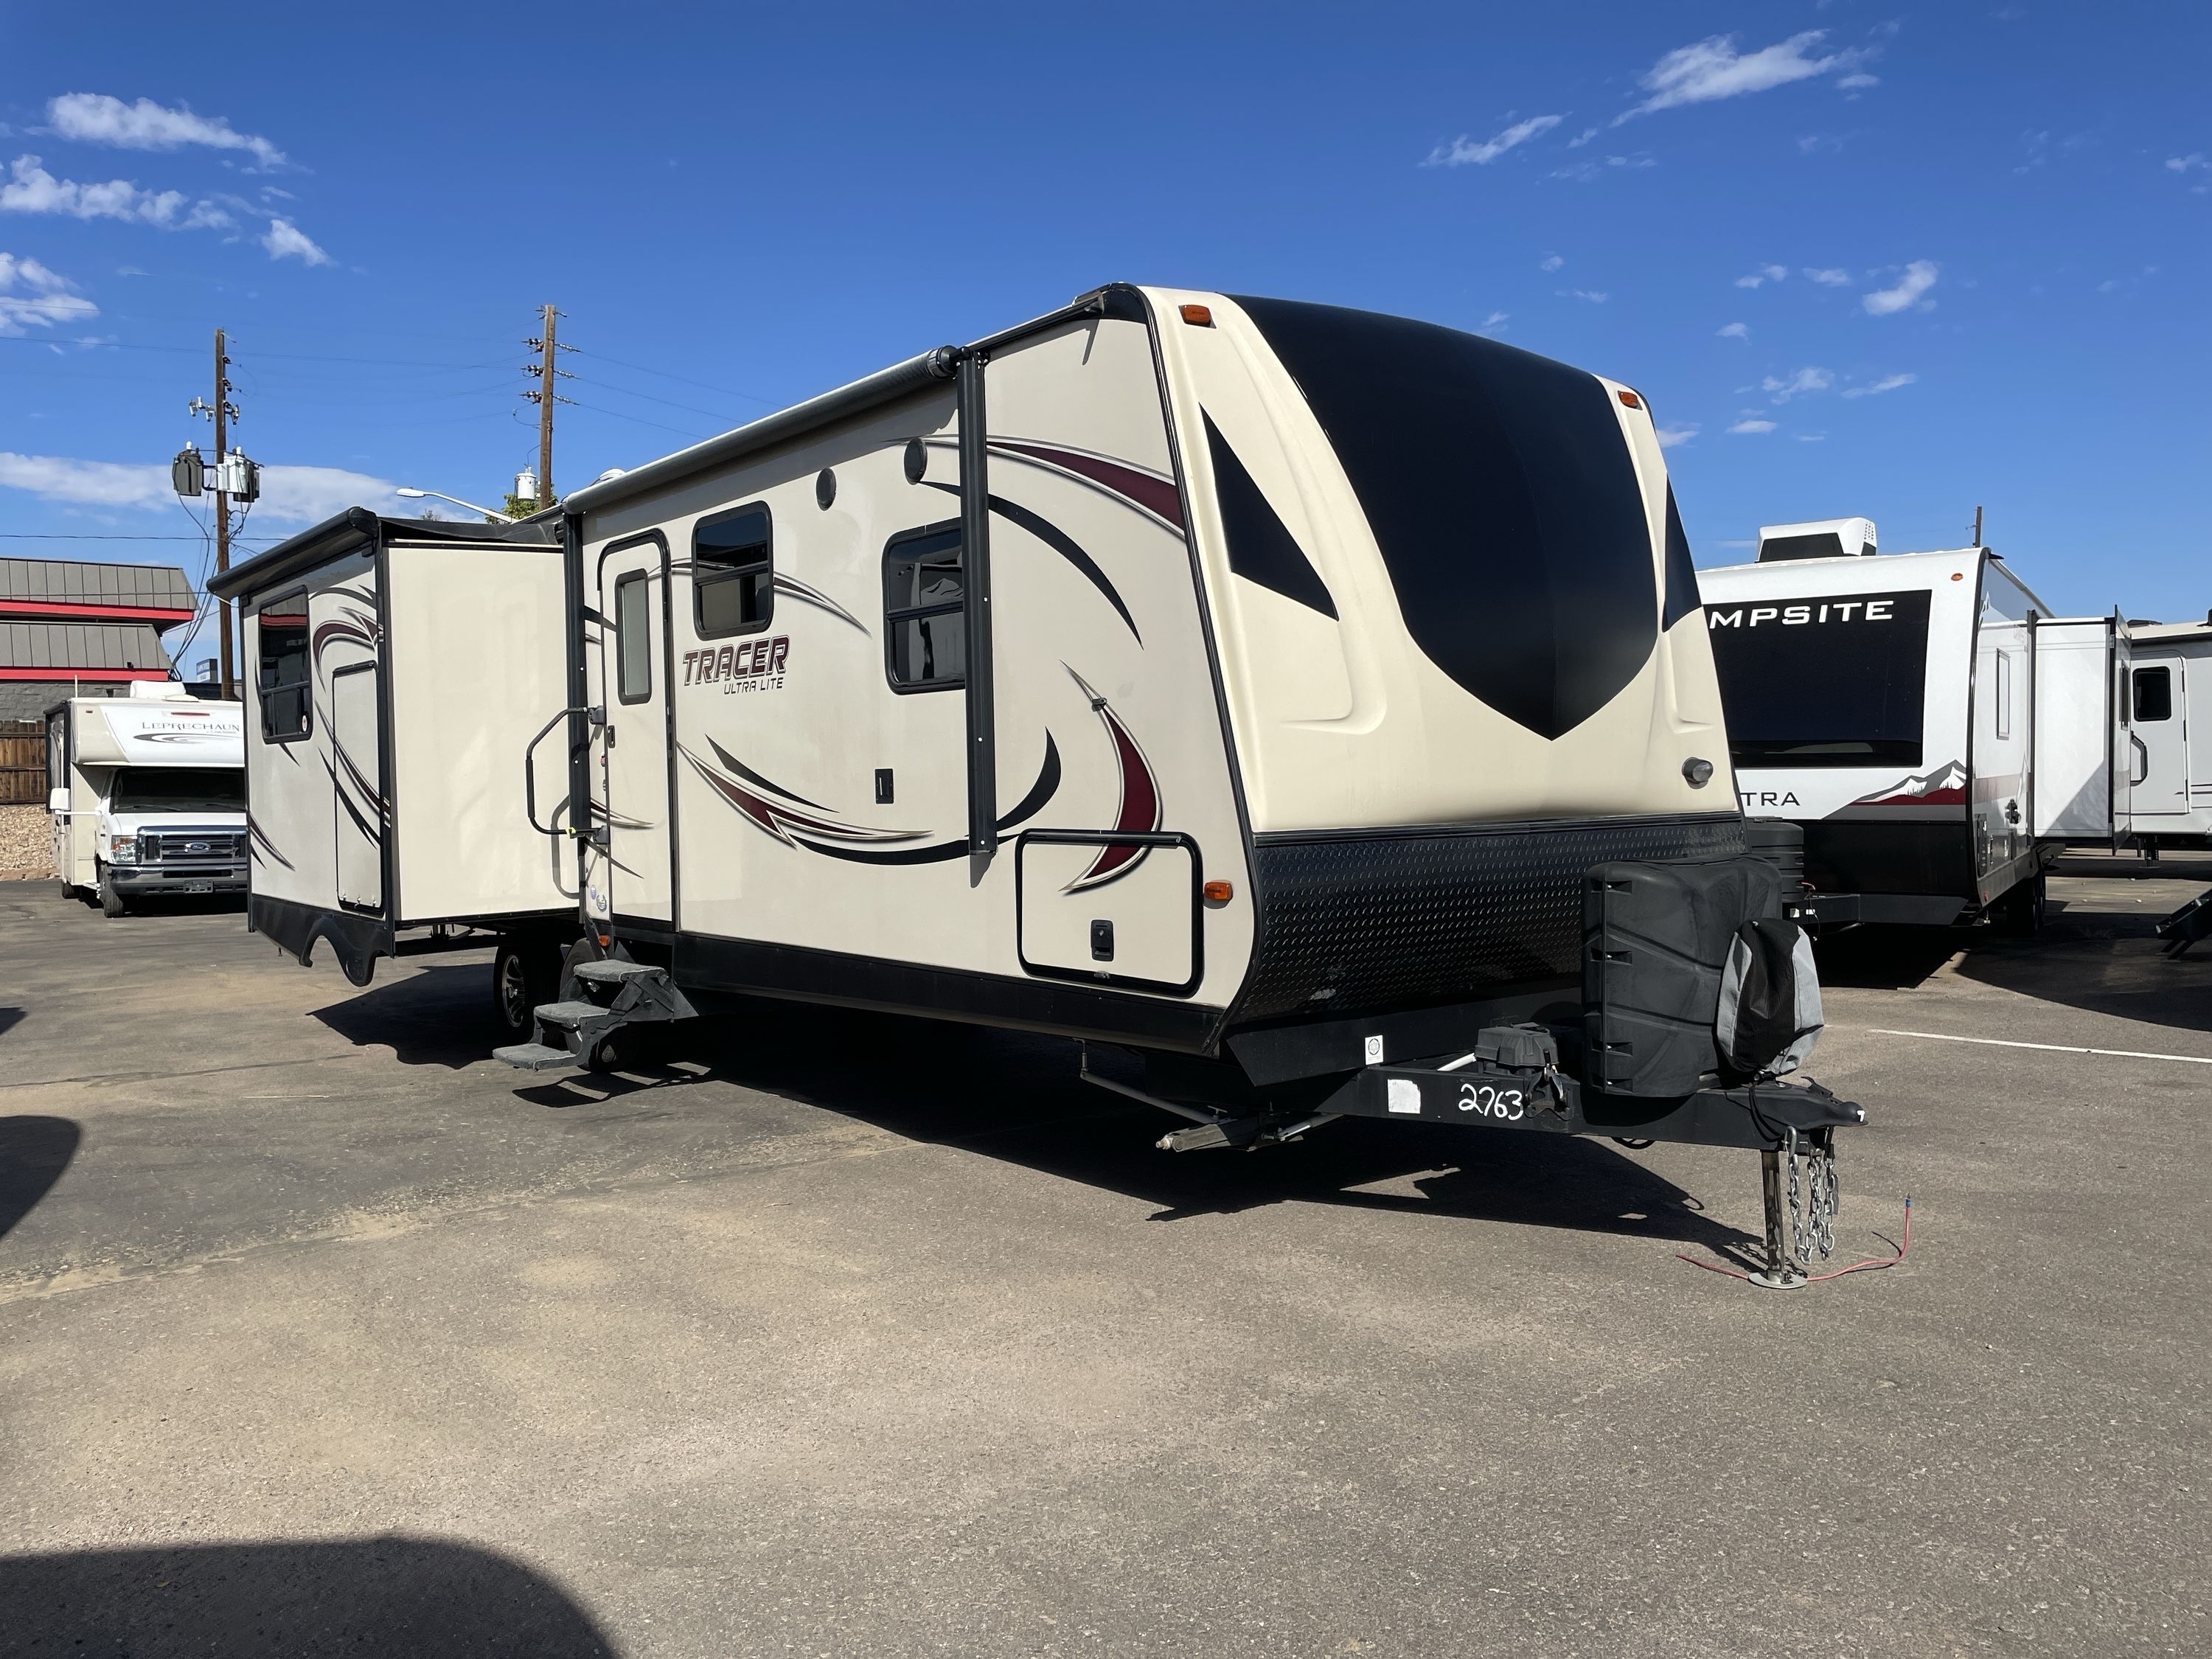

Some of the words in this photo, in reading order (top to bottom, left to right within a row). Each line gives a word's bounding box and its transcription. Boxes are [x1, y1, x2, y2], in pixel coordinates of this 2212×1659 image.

[1709, 600, 1894, 629] MPSITE
[683, 635, 791, 686] TRACER
[724, 681, 757, 695] ULTRA
[760, 677, 784, 690] LITE
[142, 722, 240, 731] LEPRECHAUN
[1740, 792, 1801, 806] TRA
[1458, 1083, 1524, 1121] 2763
